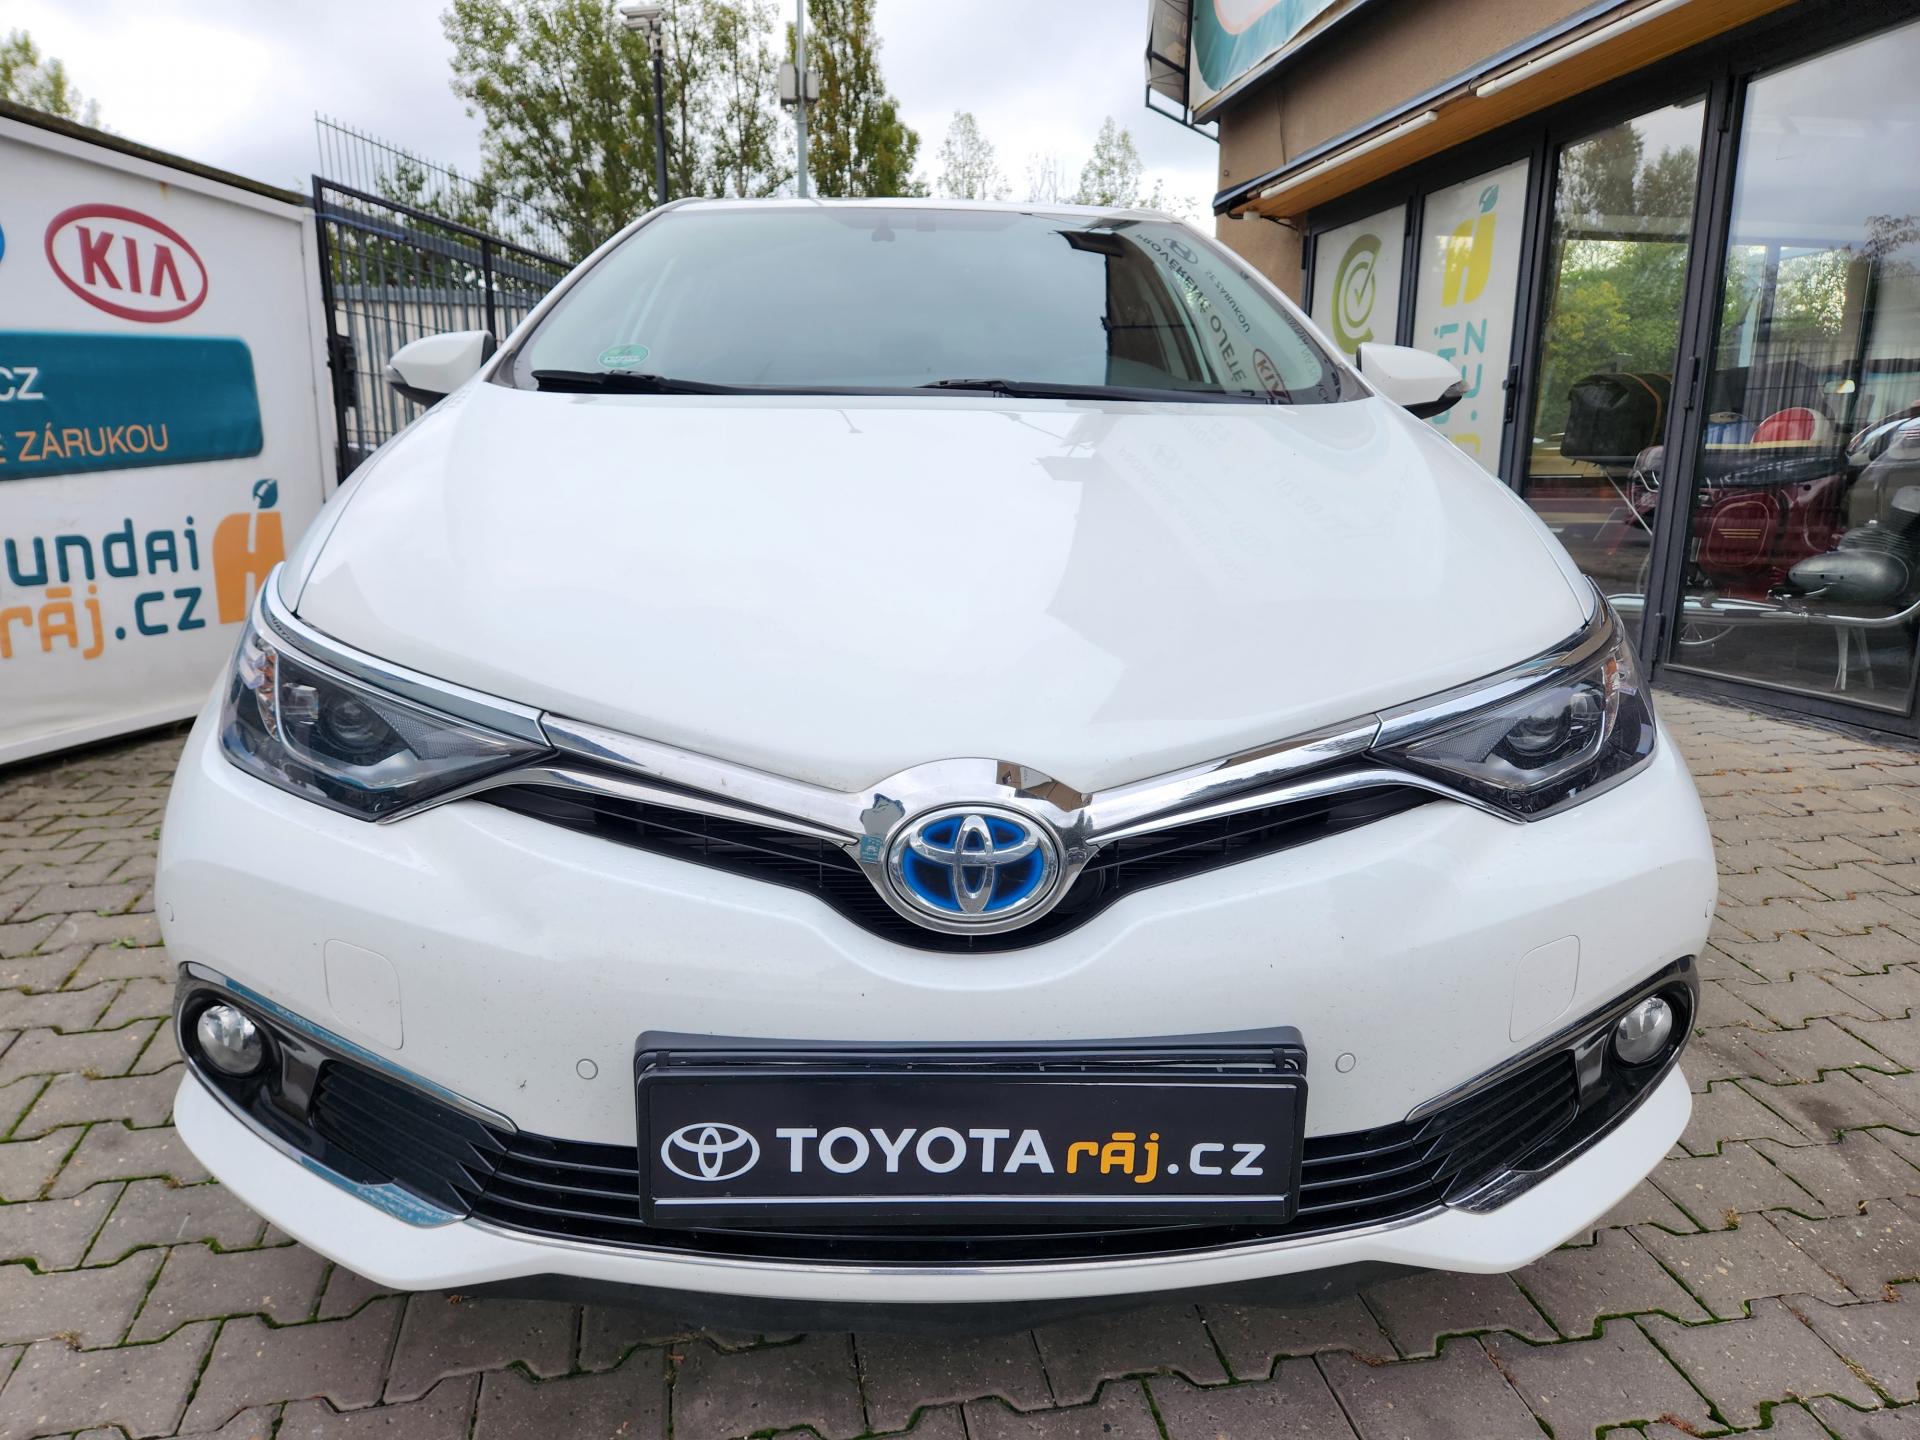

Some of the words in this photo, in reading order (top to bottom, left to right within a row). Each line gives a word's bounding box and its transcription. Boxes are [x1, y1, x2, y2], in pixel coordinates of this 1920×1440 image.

[76, 225, 187, 302] KIA
[15, 422, 168, 462] ZÁRUKOU
[776, 1126, 1055, 1174] TOYOTA
